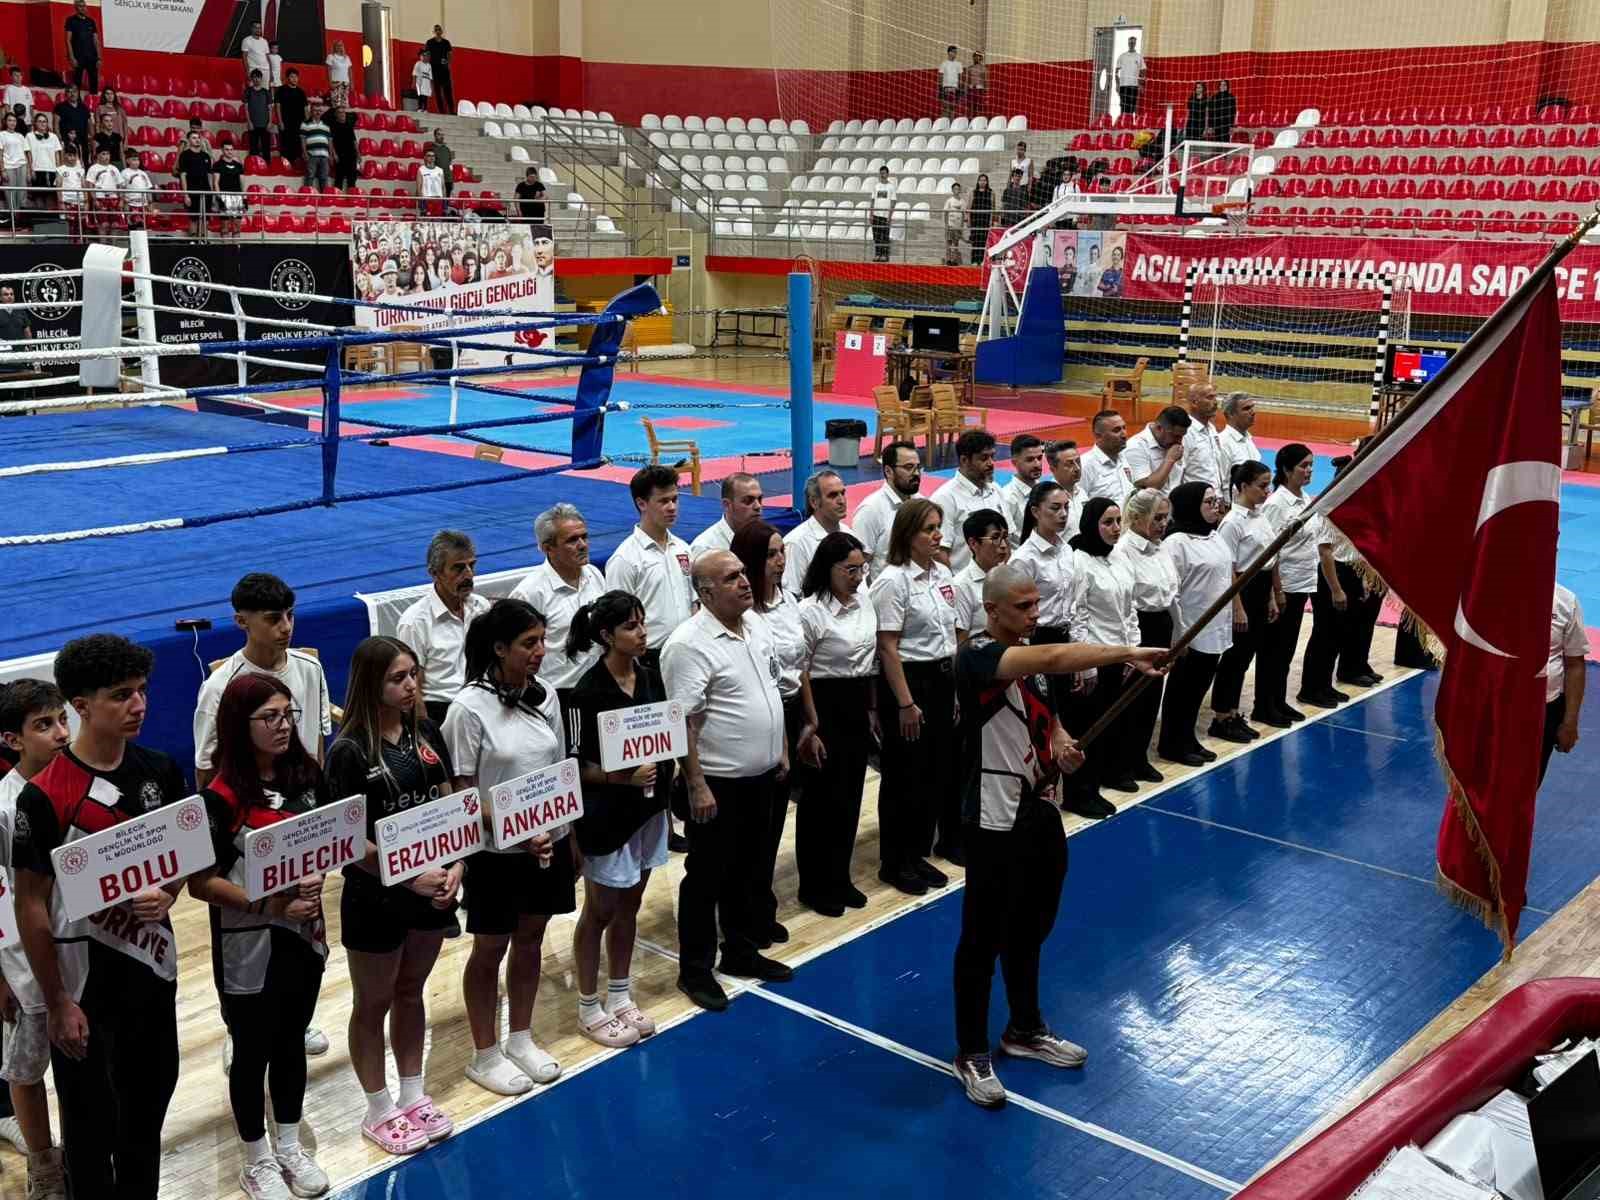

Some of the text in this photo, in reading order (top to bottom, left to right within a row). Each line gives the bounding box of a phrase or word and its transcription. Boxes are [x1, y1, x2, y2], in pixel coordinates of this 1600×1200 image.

[1131, 253, 1181, 284] ACİL
[1469, 263, 1588, 300] SADCE
[36, 328, 69, 339] BİLECİK
[161, 334, 189, 344] GENÇLİK
[199, 333, 217, 341] SPOR
[180, 319, 205, 329] BİLECİK
[63, 342, 80, 351] SPO
[622, 730, 672, 761] AYDIN
[502, 791, 579, 841] ANKARA
[134, 832, 145, 842] VE
[387, 821, 480, 877] ERZURUM
[99, 850, 179, 903] BOLU
[263, 835, 354, 892] BİLECİK
